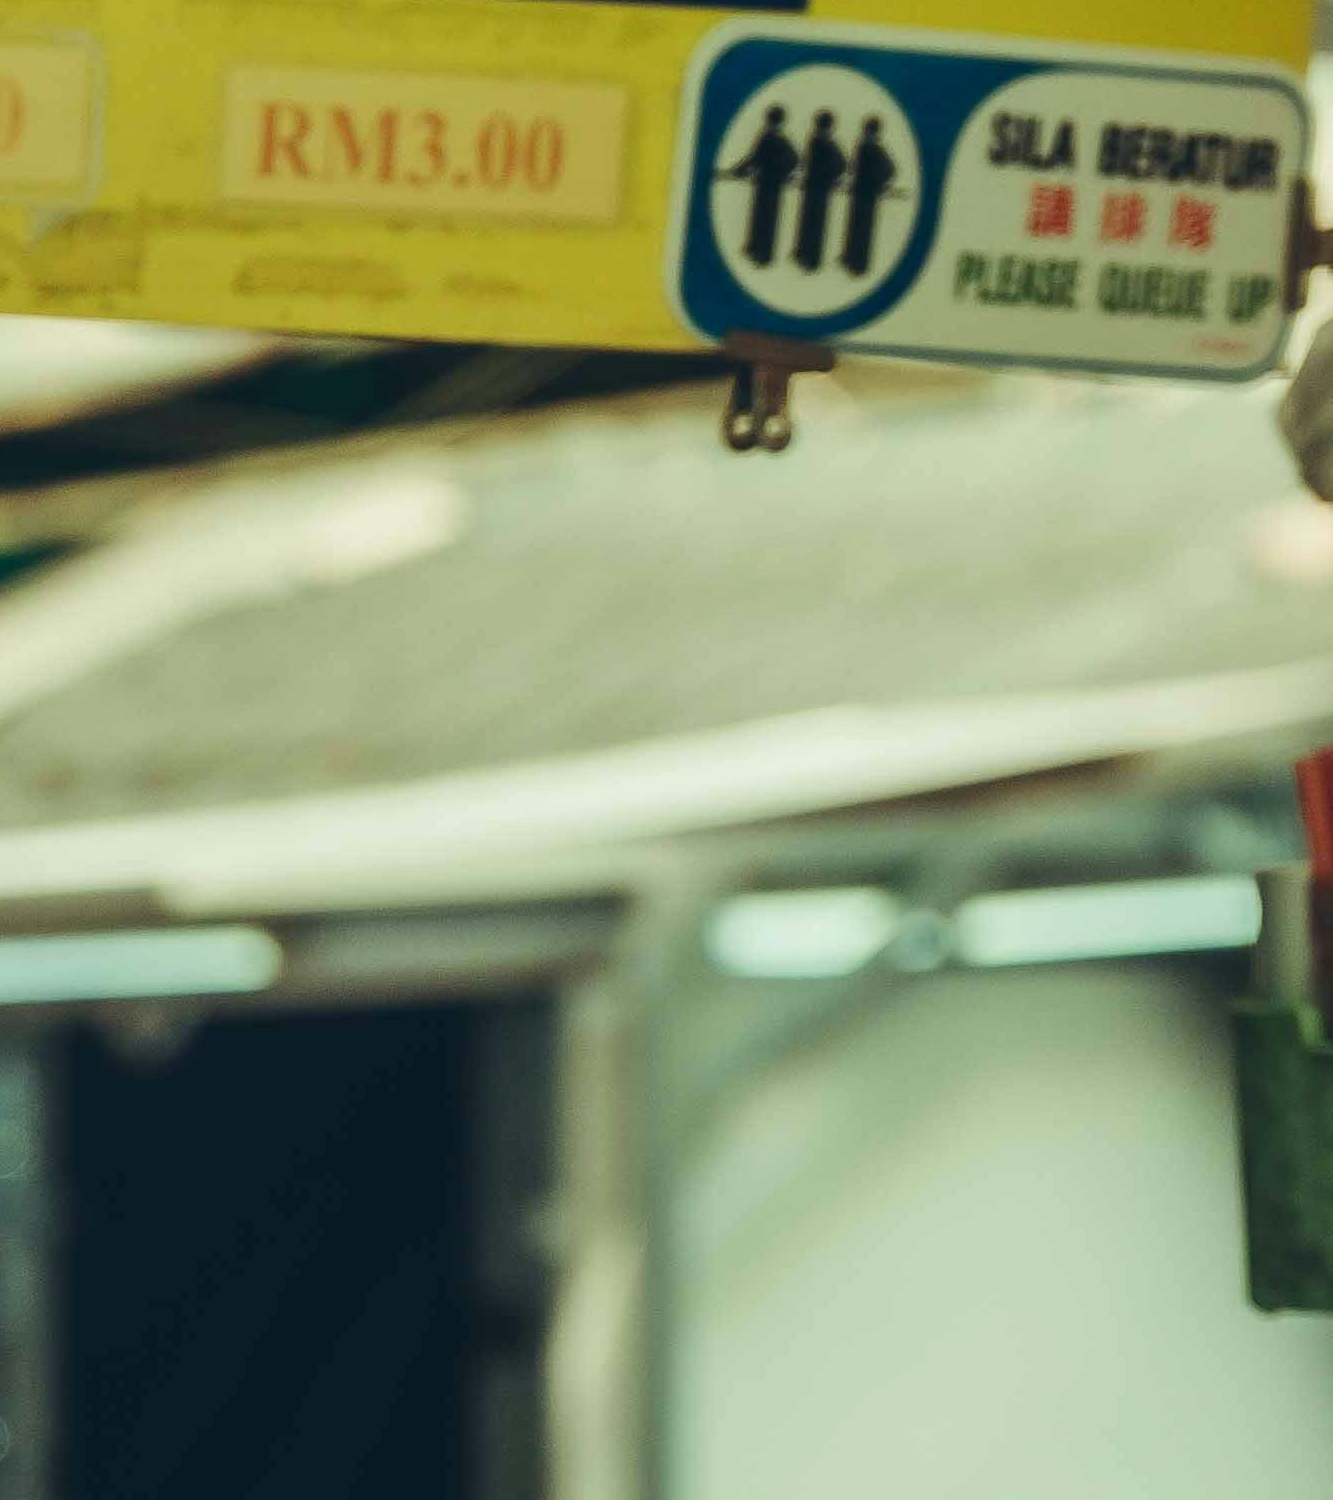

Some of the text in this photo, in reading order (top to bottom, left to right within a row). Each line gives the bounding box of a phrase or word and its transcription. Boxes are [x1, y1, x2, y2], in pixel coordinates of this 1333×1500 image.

[252, 96, 568, 196] RM3.00
[987, 109, 1079, 173] SILA
[954, 250, 1279, 326] PLEASE QUEUE UP
